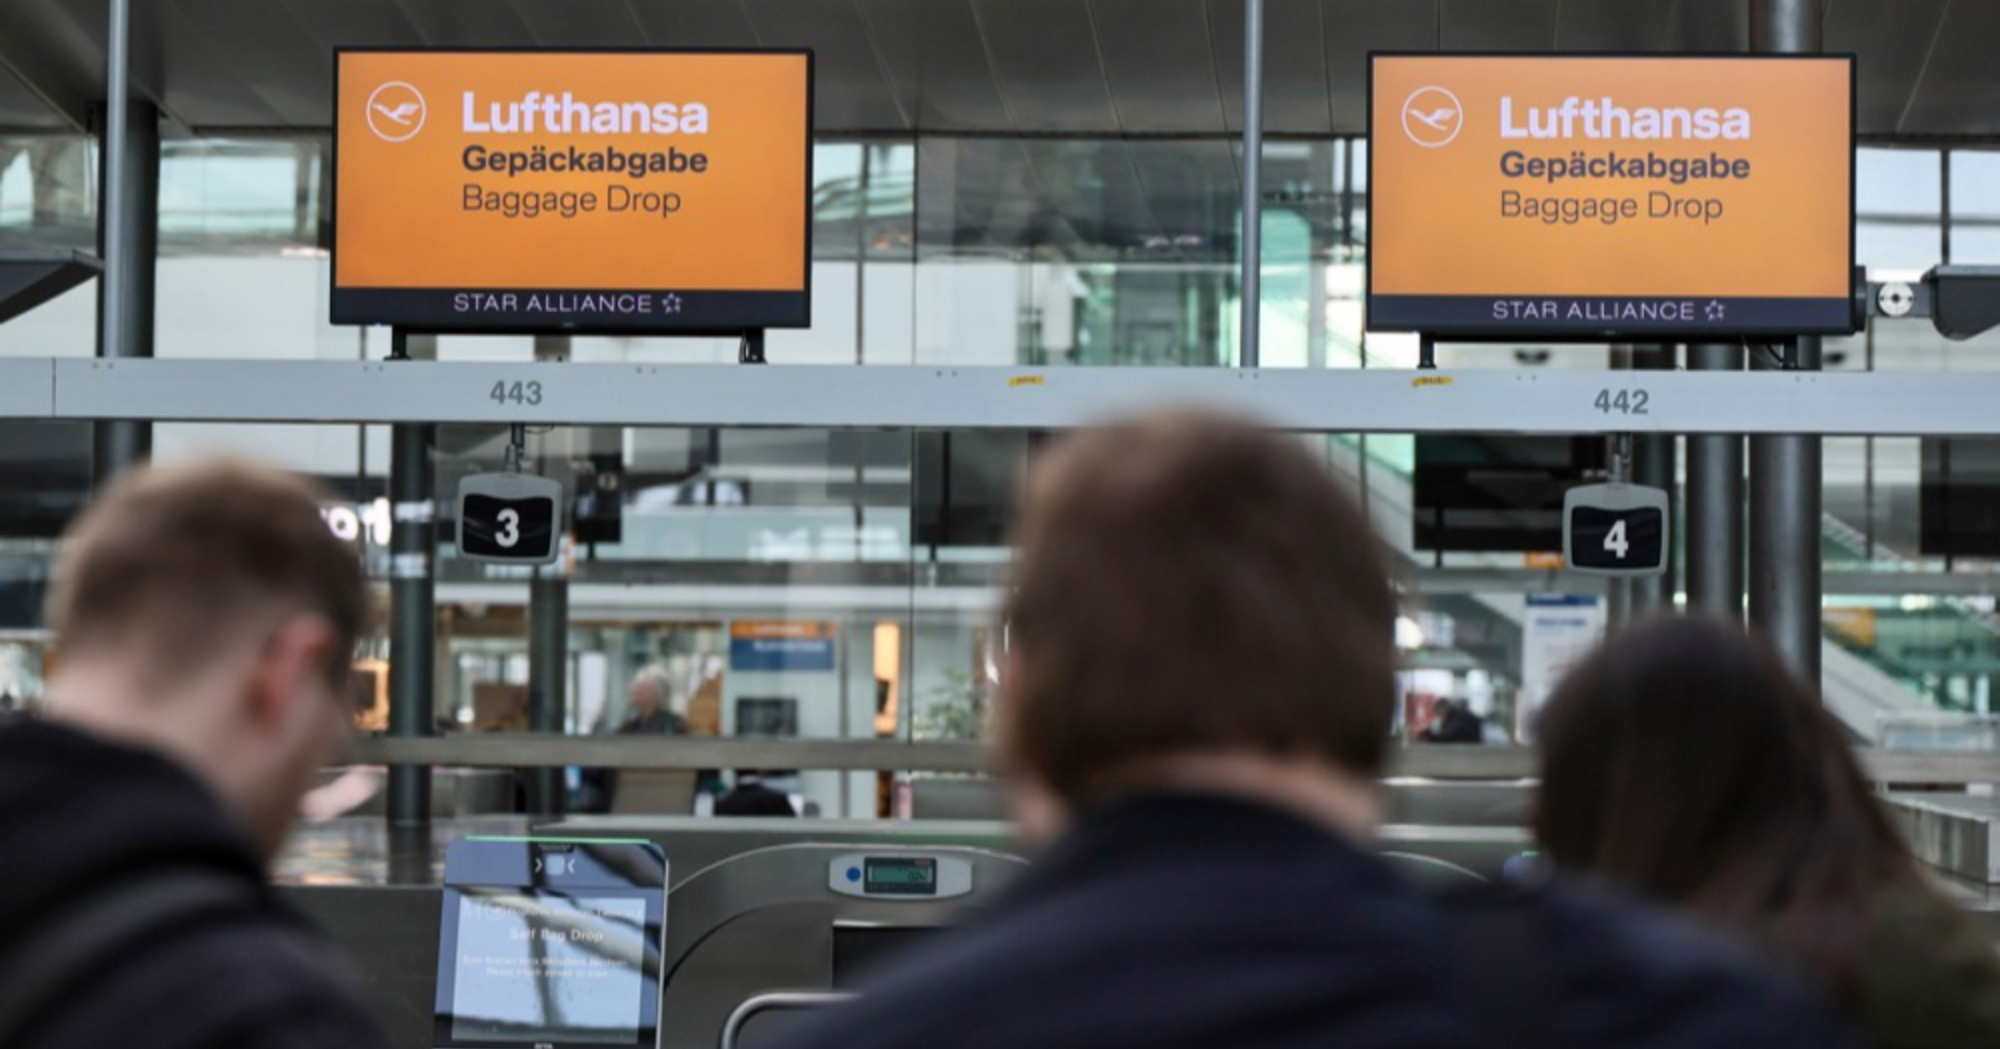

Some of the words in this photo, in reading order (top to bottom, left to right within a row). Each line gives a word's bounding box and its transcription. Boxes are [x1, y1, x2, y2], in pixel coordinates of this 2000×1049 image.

[463, 91, 708, 134] Lufthansa
[1501, 96, 1750, 139] Lufthansa
[463, 145, 707, 178] Gepäckabgabe
[1501, 151, 1750, 184] Gepäckabgabe
[463, 184, 597, 218] Baggage
[608, 185, 681, 218] Drop
[1501, 190, 1637, 224] Baggage
[1648, 191, 1723, 224] Drop
[454, 293, 518, 312] STAR
[526, 295, 651, 313] ALLIANCE
[1493, 301, 1558, 319] STAR
[1567, 302, 1694, 320] ALLIANCE
[490, 380, 543, 405] 443
[1594, 388, 1649, 415] 442
[495, 508, 520, 548] 3
[1603, 520, 1629, 558] 4
[571, 930, 605, 945] Drop
